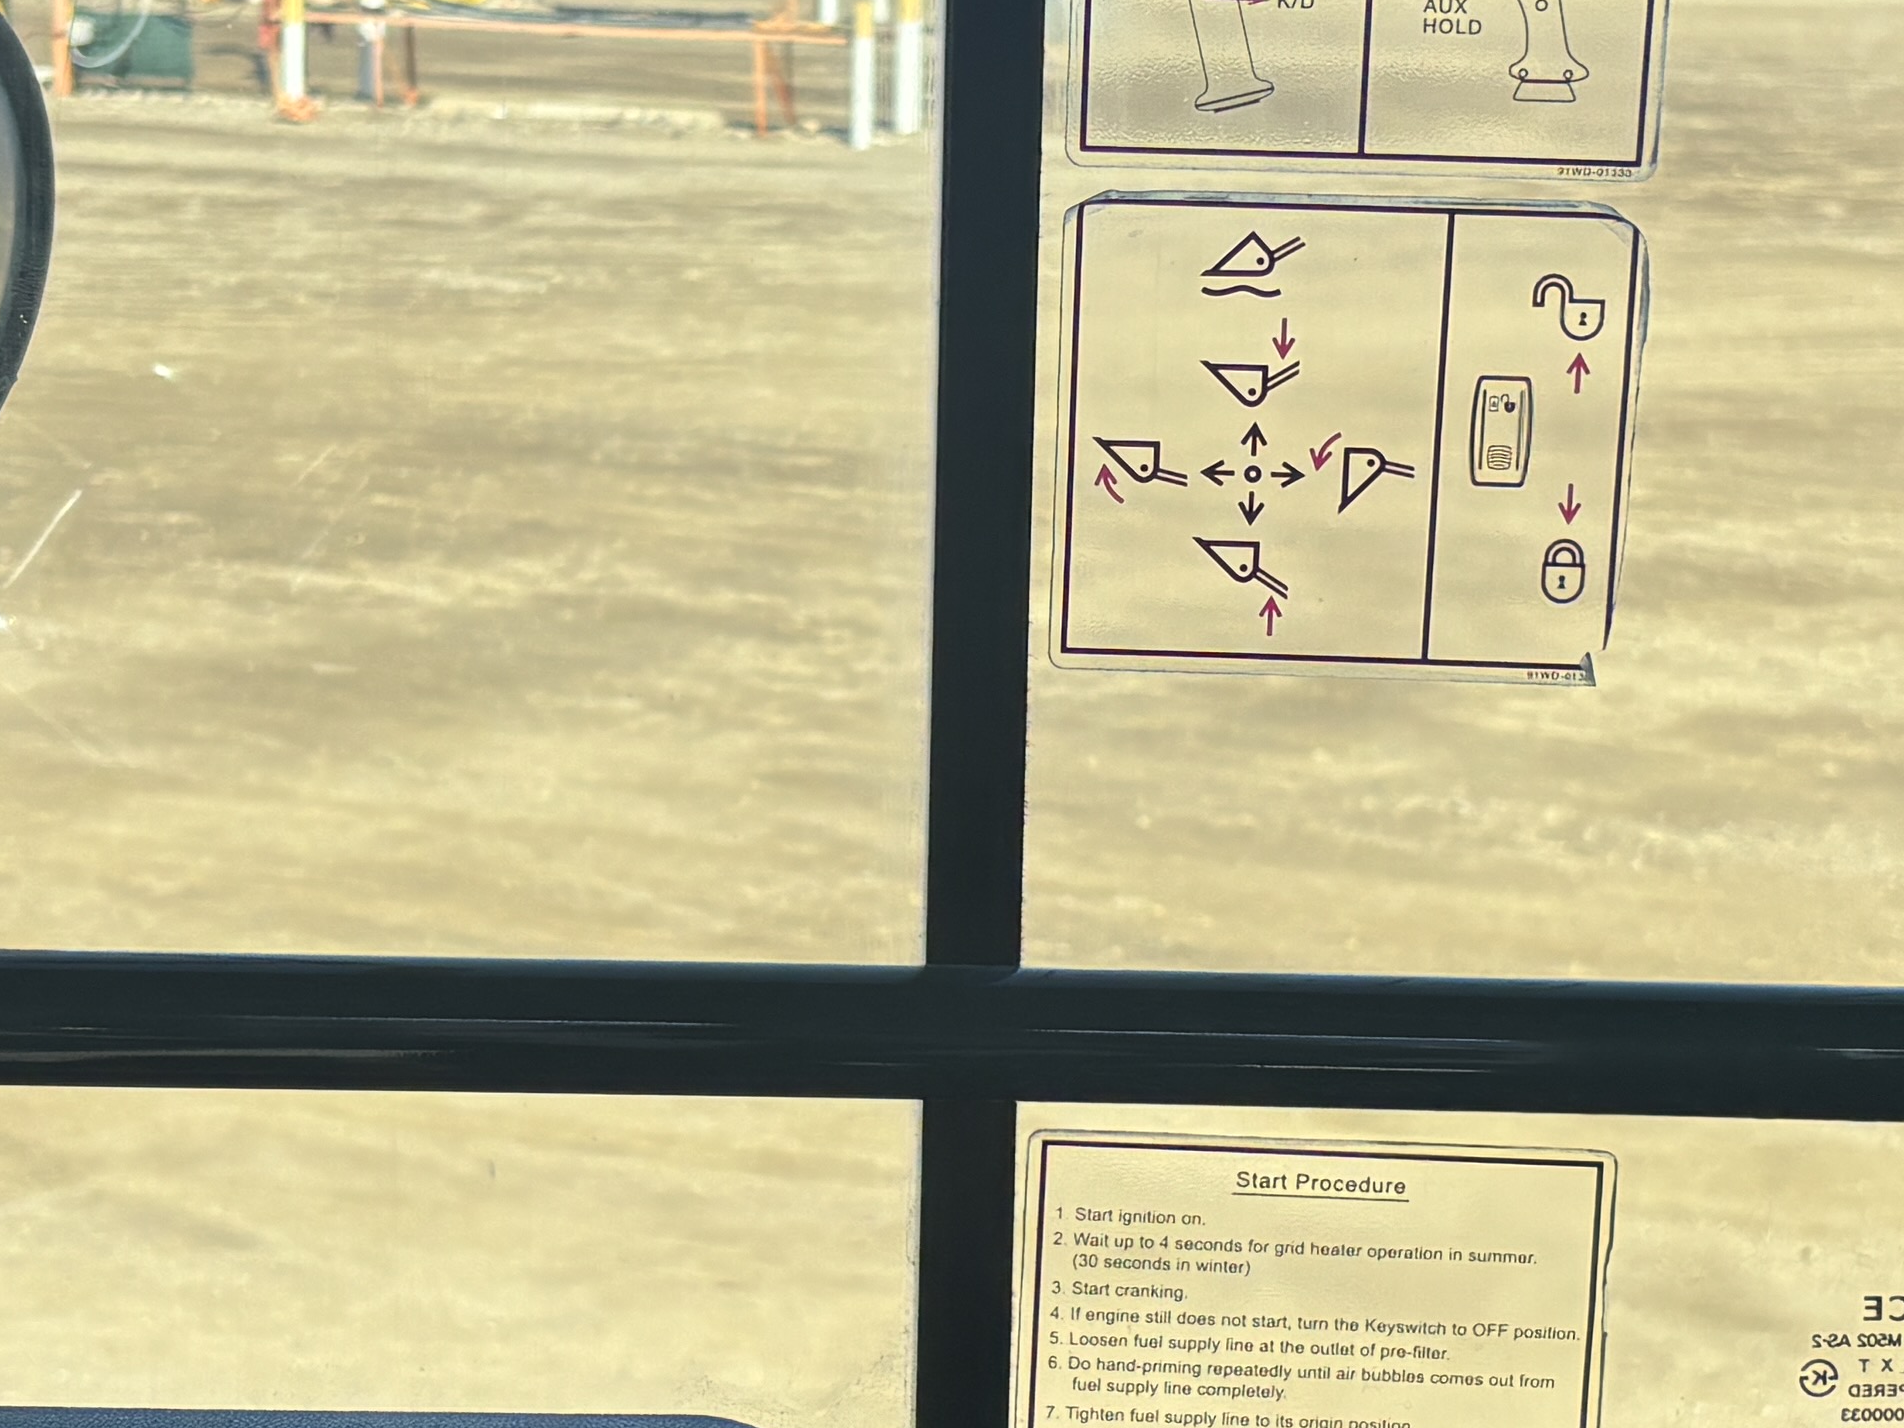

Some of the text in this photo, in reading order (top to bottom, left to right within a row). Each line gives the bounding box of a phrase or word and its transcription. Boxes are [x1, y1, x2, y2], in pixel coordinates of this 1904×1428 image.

[1422, 18, 1482, 36] HOLD
[1236, 1170, 1406, 1195] Start Procedure
[1075, 1206, 1206, 1227] Start ignition on.
[1073, 1232, 1537, 1265] Wait up 4 seconds for grid heater operation summer.
[1072, 1253, 1251, 1277] (30 seconds winter)
[1072, 1280, 1188, 1303] Start cranking.
[1085, 1310, 1580, 1341] engine still does not start, turn the Keyswitch OFF position.
[1069, 1331, 1450, 1362] Loosen fuel supply line the outlet pre-filter.
[1068, 1355, 1555, 1389] Do hand-priming repeatedly until air bubbles comes out from
[1072, 1376, 1286, 1402] fuel supply line completely.
[1065, 1405, 1125, 1424] Tighten
[1130, 1407, 1159, 1423] fuel
[1164, 1411, 1217, 1428] supply
[1221, 1411, 1250, 1427] line
[1275, 1413, 1294, 1428] its
